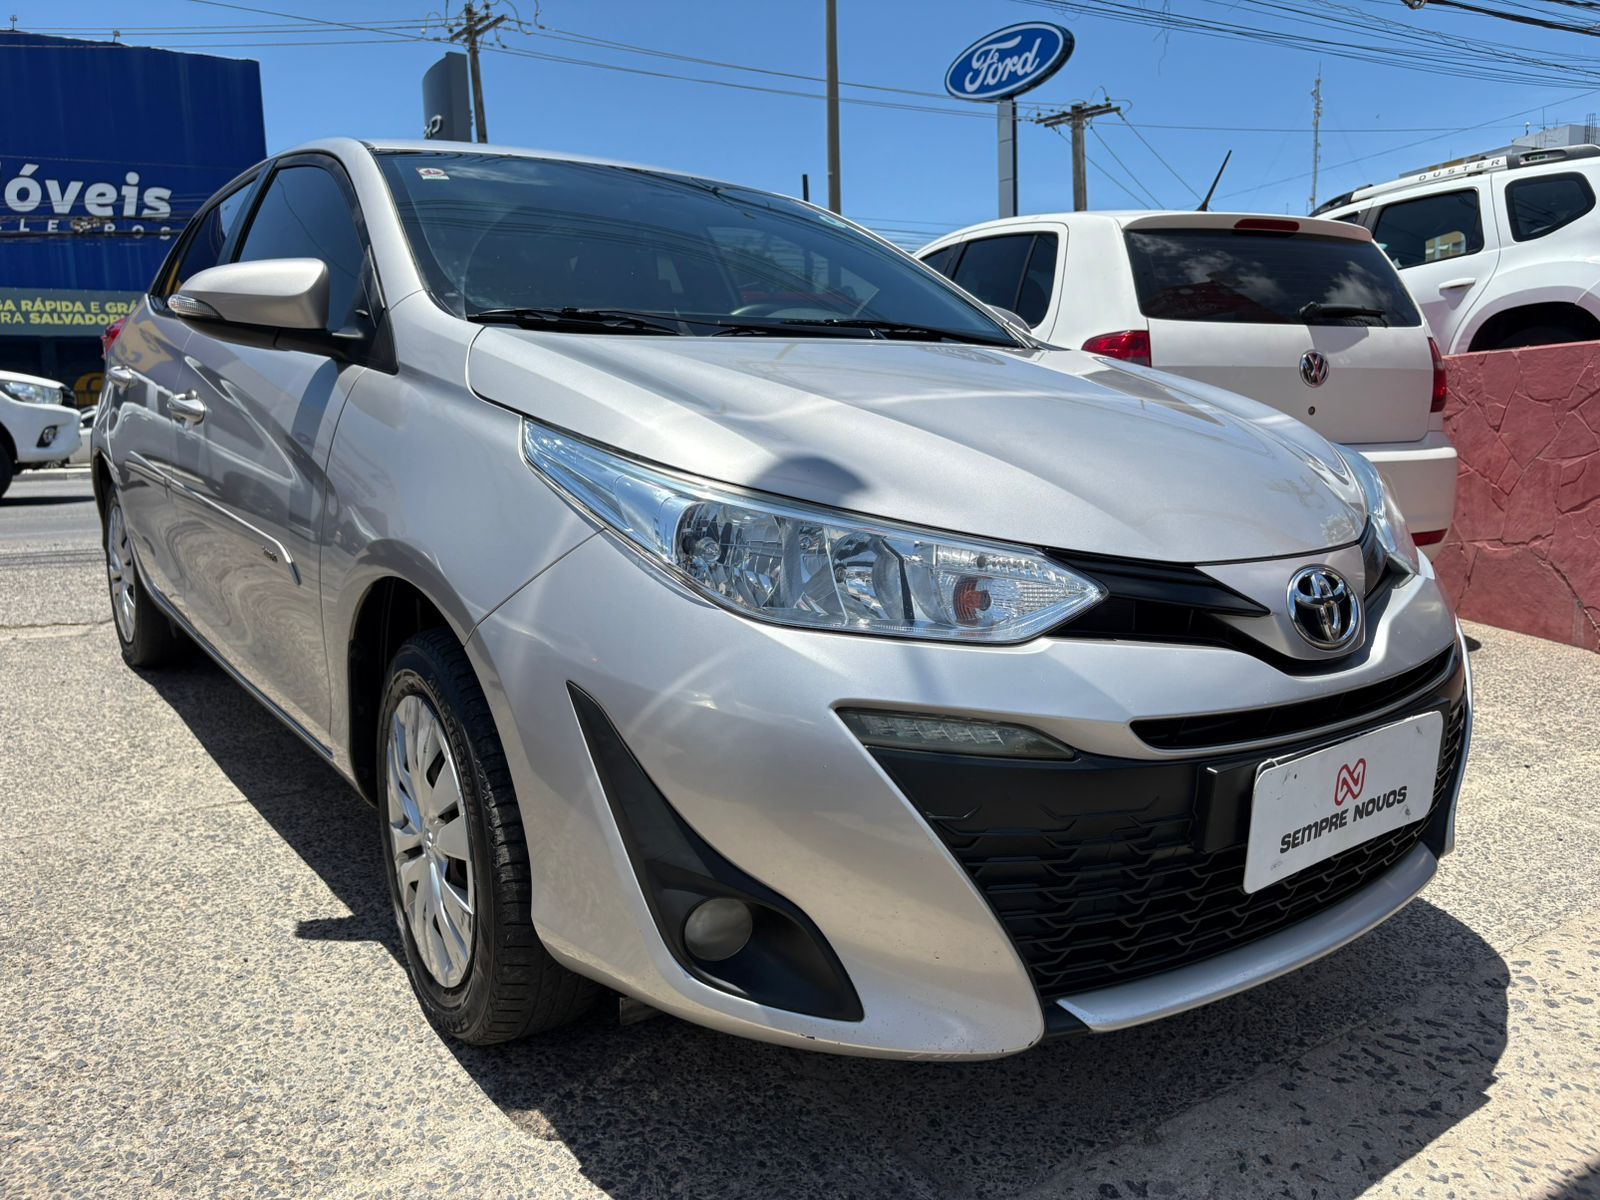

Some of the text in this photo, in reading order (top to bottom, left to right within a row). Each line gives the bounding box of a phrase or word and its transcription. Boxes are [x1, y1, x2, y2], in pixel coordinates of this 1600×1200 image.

[964, 35, 1042, 92] Ford
[1418, 159, 1501, 181] DUSTER
[21, 296, 86, 313] RÁPIDA
[90, 301, 101, 313] E
[29, 312, 125, 326] SALVADOR
[1279, 808, 1349, 853] SEMPRE
